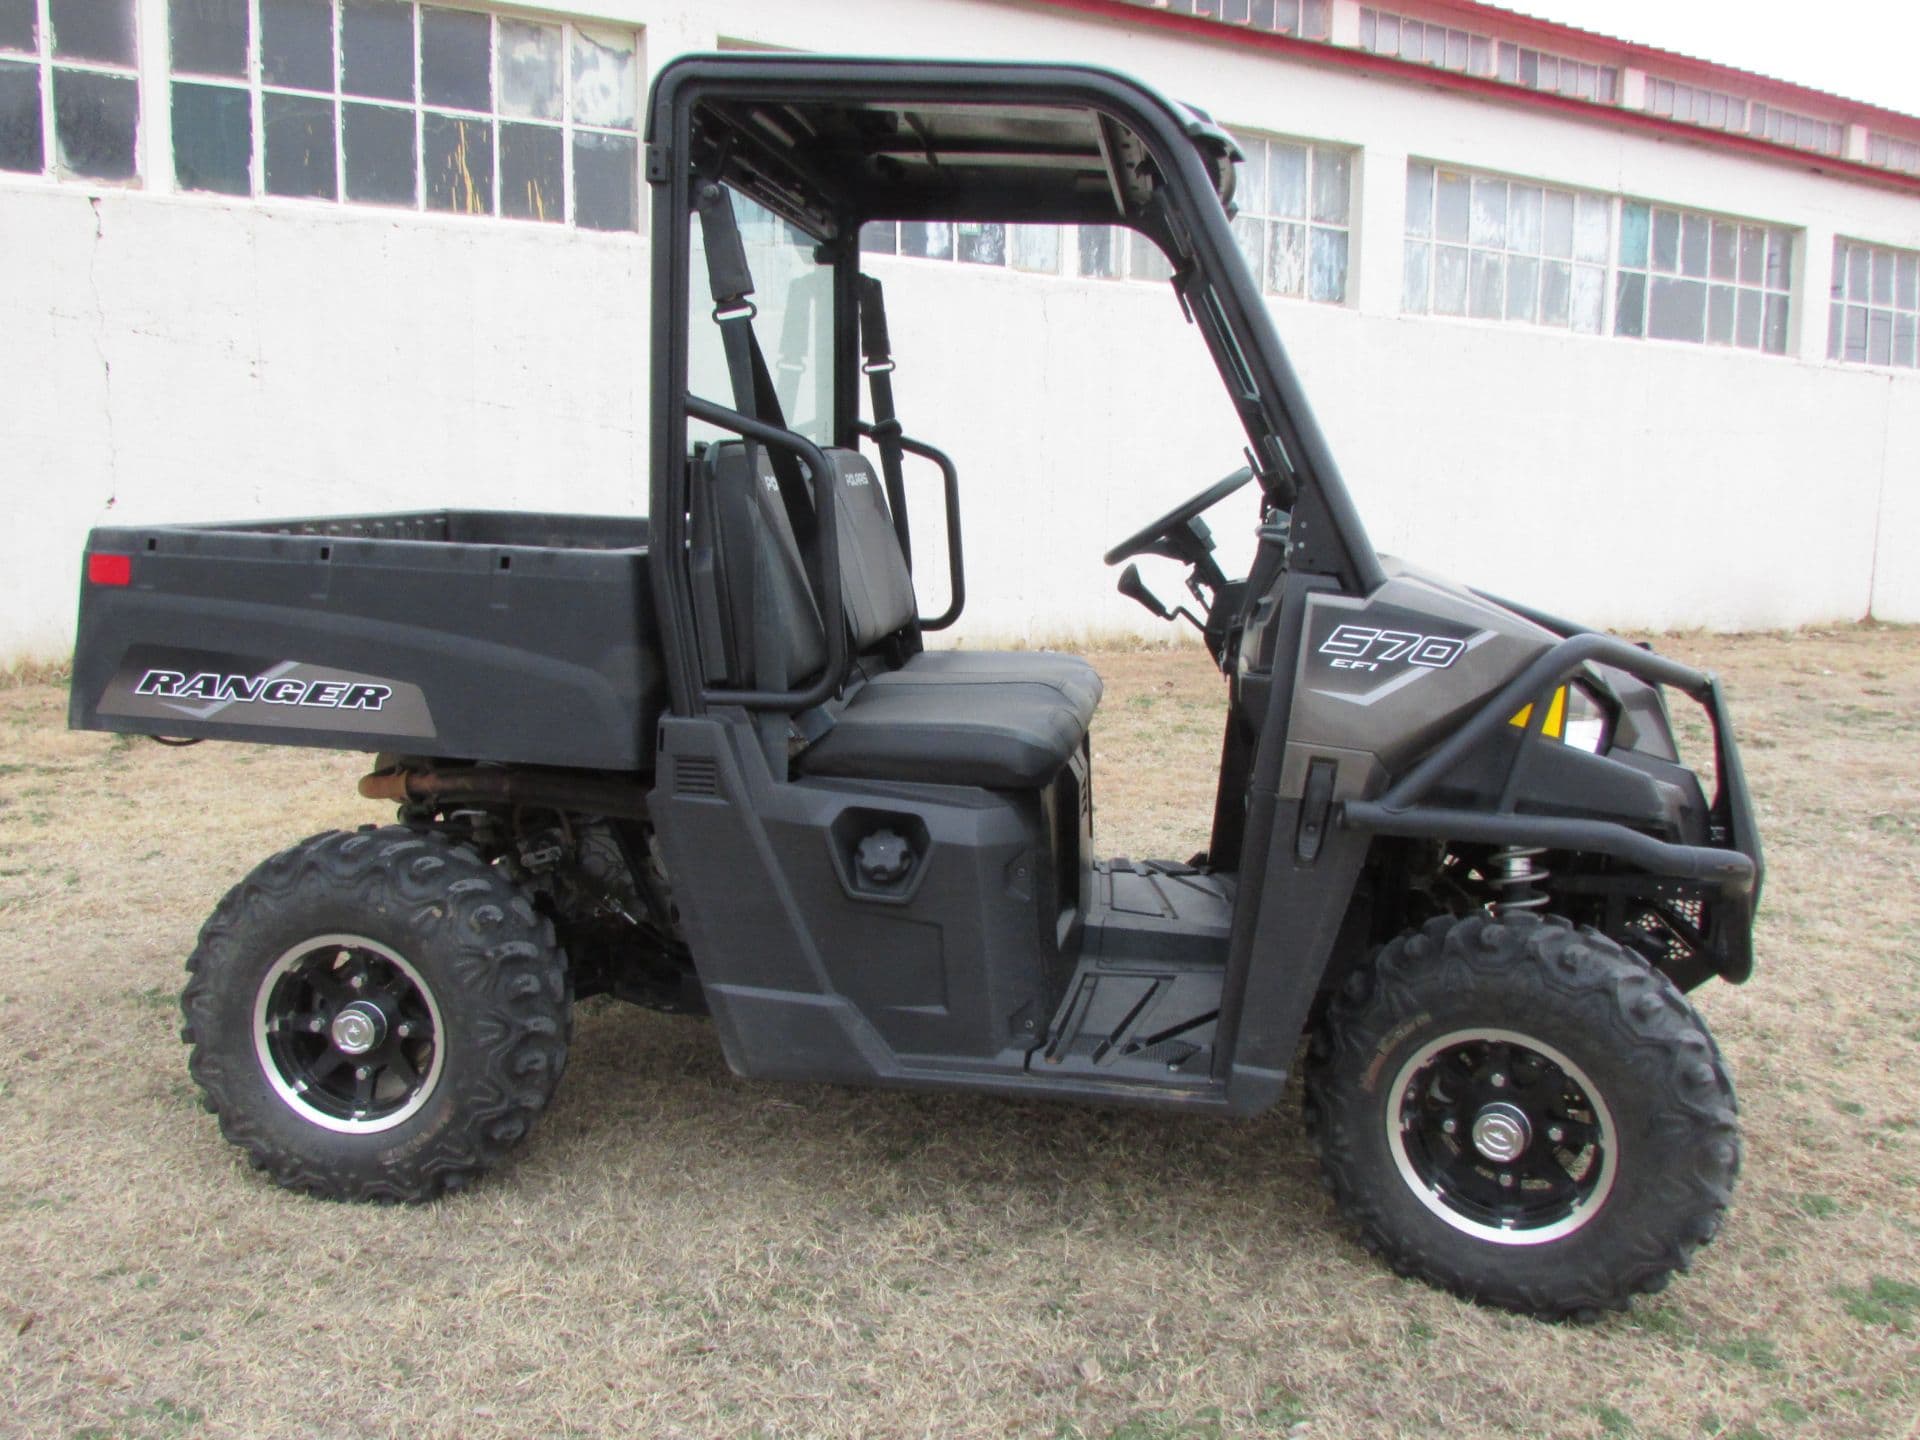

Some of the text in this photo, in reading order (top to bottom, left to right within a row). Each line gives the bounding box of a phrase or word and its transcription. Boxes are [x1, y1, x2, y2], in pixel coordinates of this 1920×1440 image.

[1319, 624, 1466, 667] 570
[1329, 658, 1379, 672] EFI
[134, 669, 392, 711] RANGER
